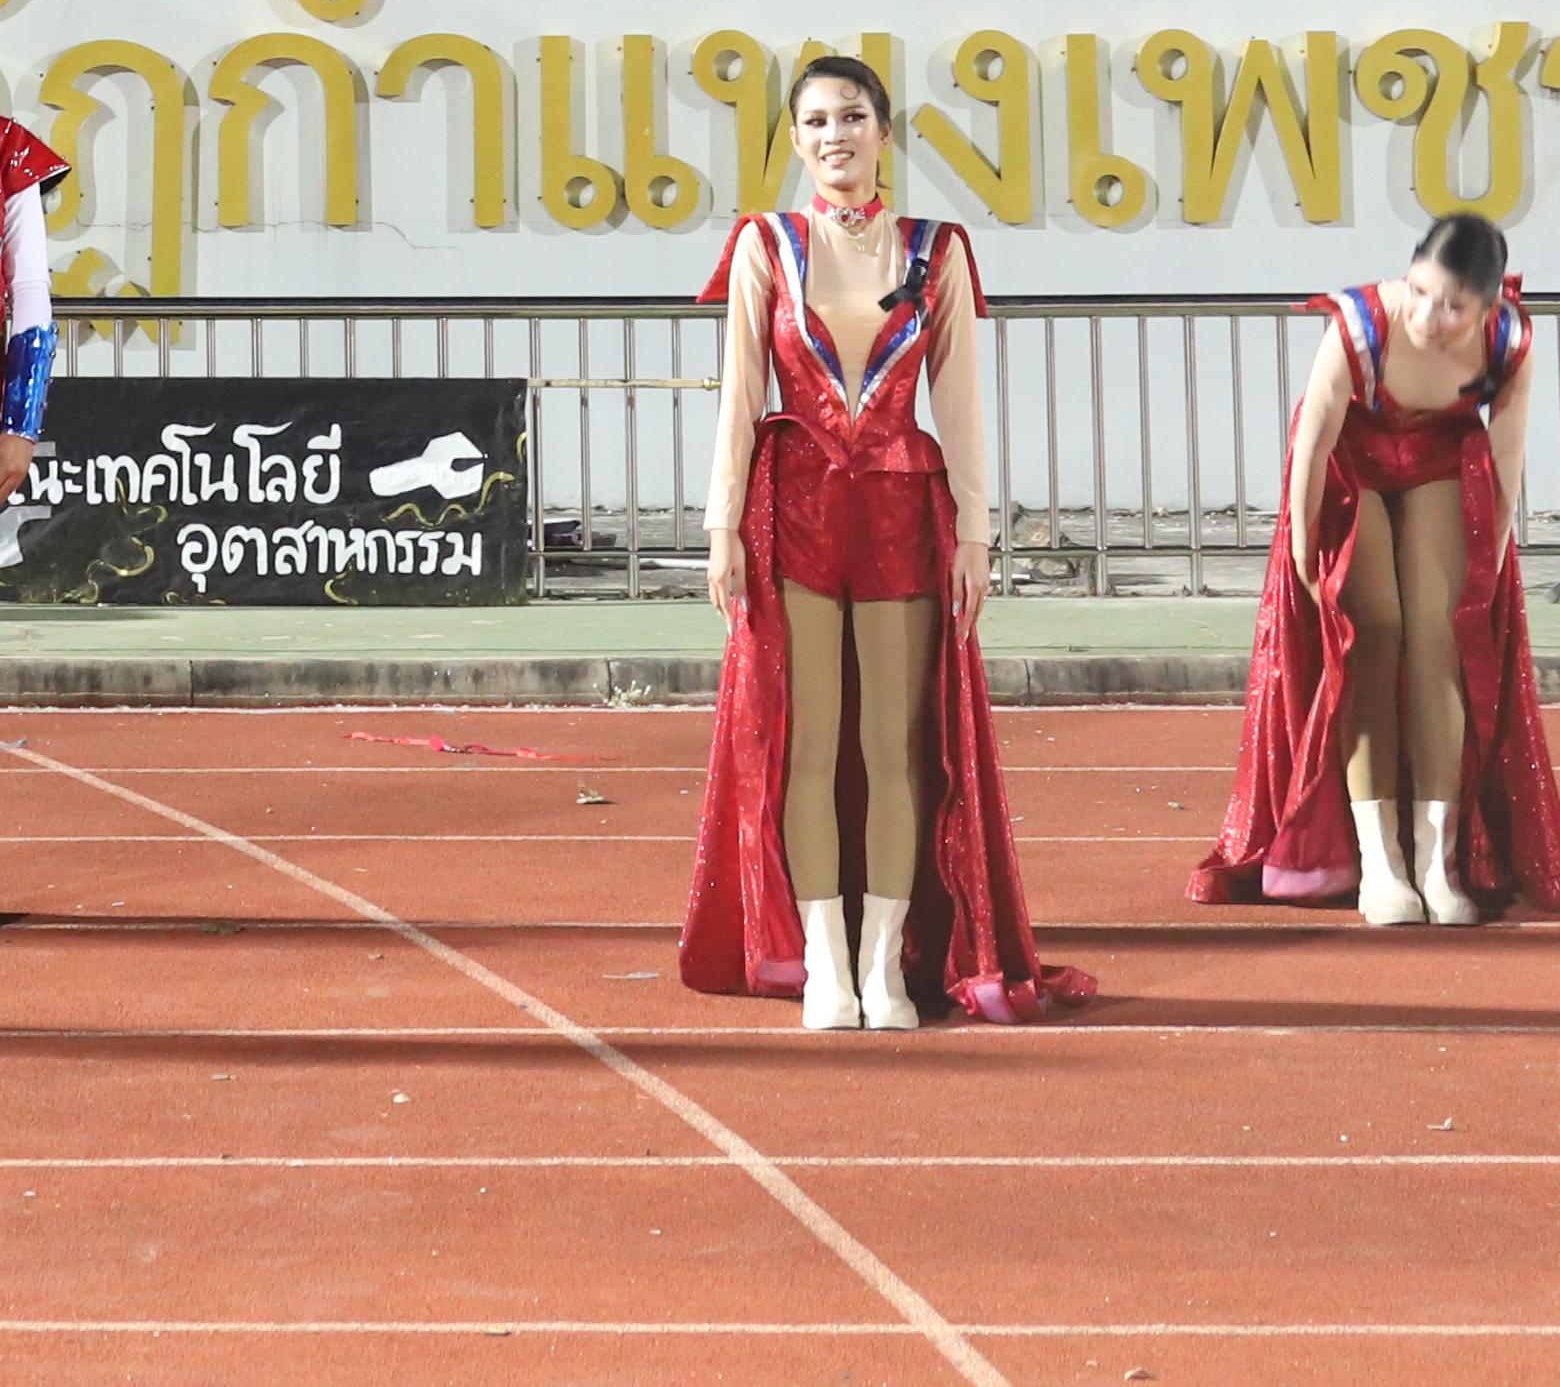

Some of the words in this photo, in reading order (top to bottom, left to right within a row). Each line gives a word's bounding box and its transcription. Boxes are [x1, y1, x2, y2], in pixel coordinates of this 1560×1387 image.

[8, 422, 343, 506] ณะเทคโนโลยี
[178, 520, 483, 594] อุตสาหกรรม
